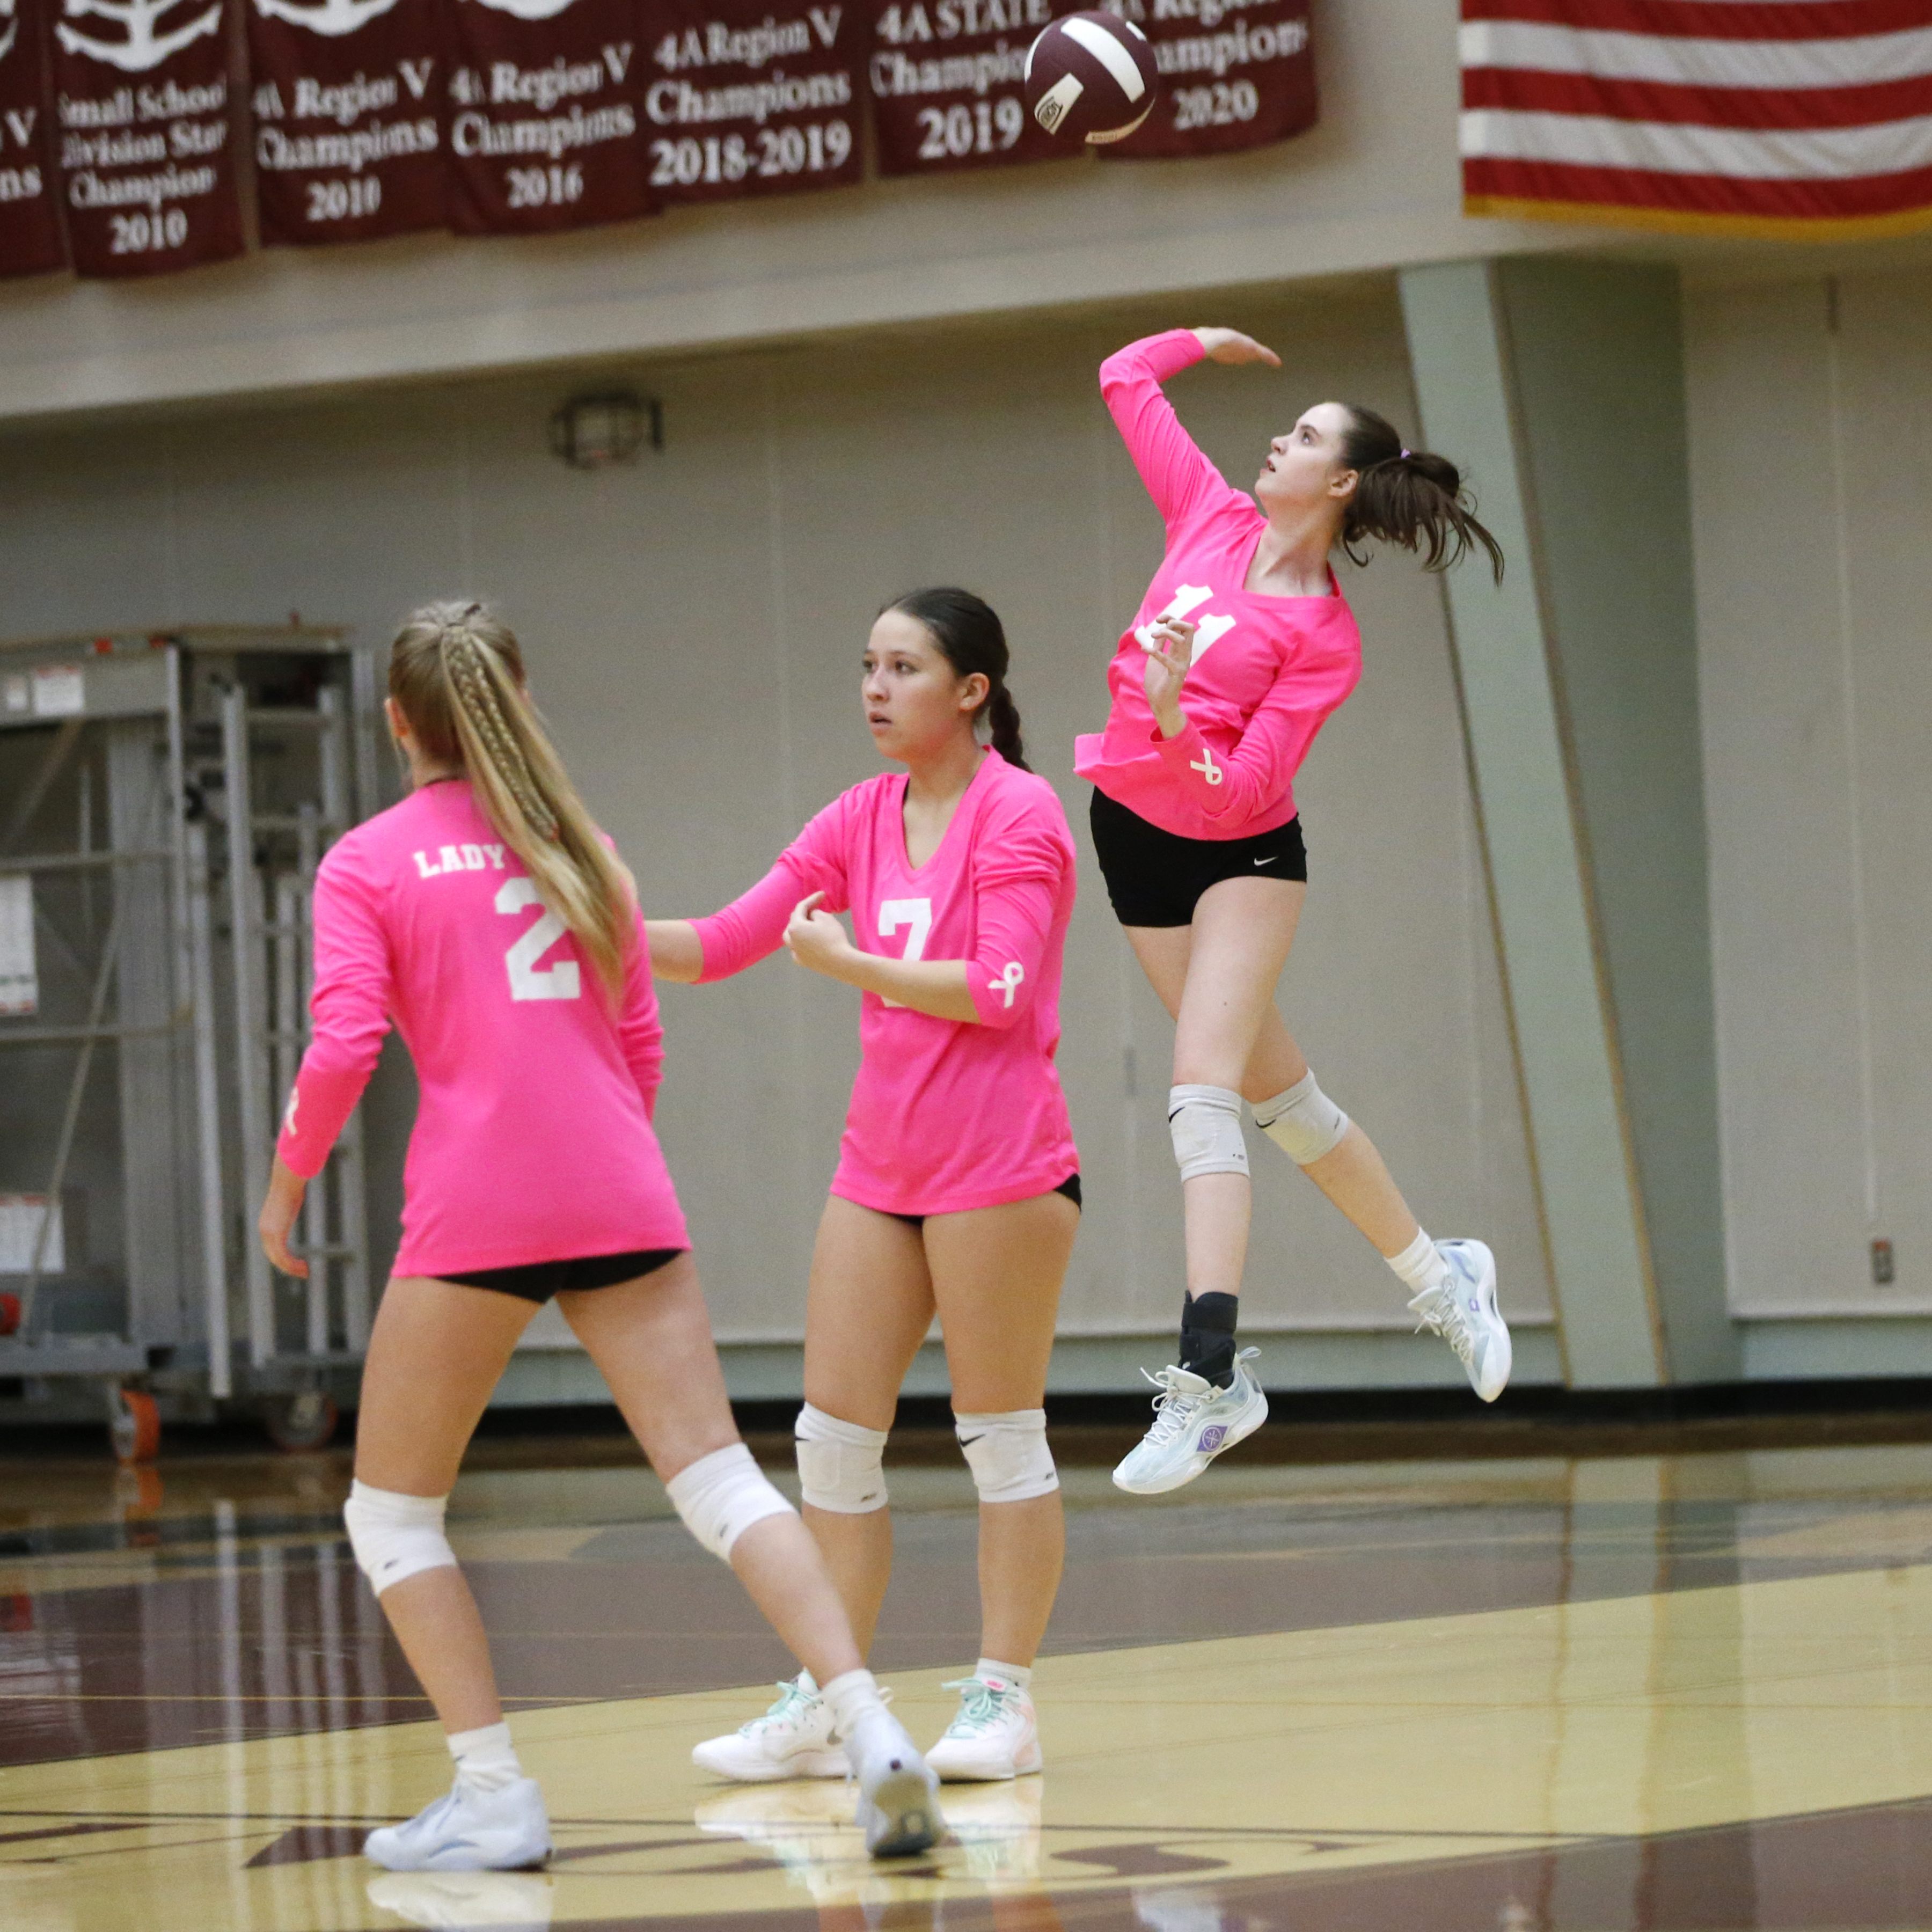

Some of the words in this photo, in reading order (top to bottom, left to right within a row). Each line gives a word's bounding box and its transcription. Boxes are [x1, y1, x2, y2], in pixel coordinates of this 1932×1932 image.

[653, 28, 706, 72] 4A
[705, 14, 811, 68] Region
[807, 3, 843, 49] V
[294, 70, 398, 126] Region
[398, 56, 435, 100] V
[491, 55, 604, 112] Region
[602, 41, 634, 84] V
[645, 68, 852, 125] Champions
[256, 116, 440, 173] Champions
[649, 119, 852, 186] 2018-2019
[915, 97, 1023, 159] 2019
[69, 162, 216, 212] Champion
[306, 174, 382, 222] 2010
[109, 207, 188, 254] 2010
[413, 843, 506, 878] LADY
[494, 877, 581, 1000] 2
[877, 898, 932, 1008] 7
